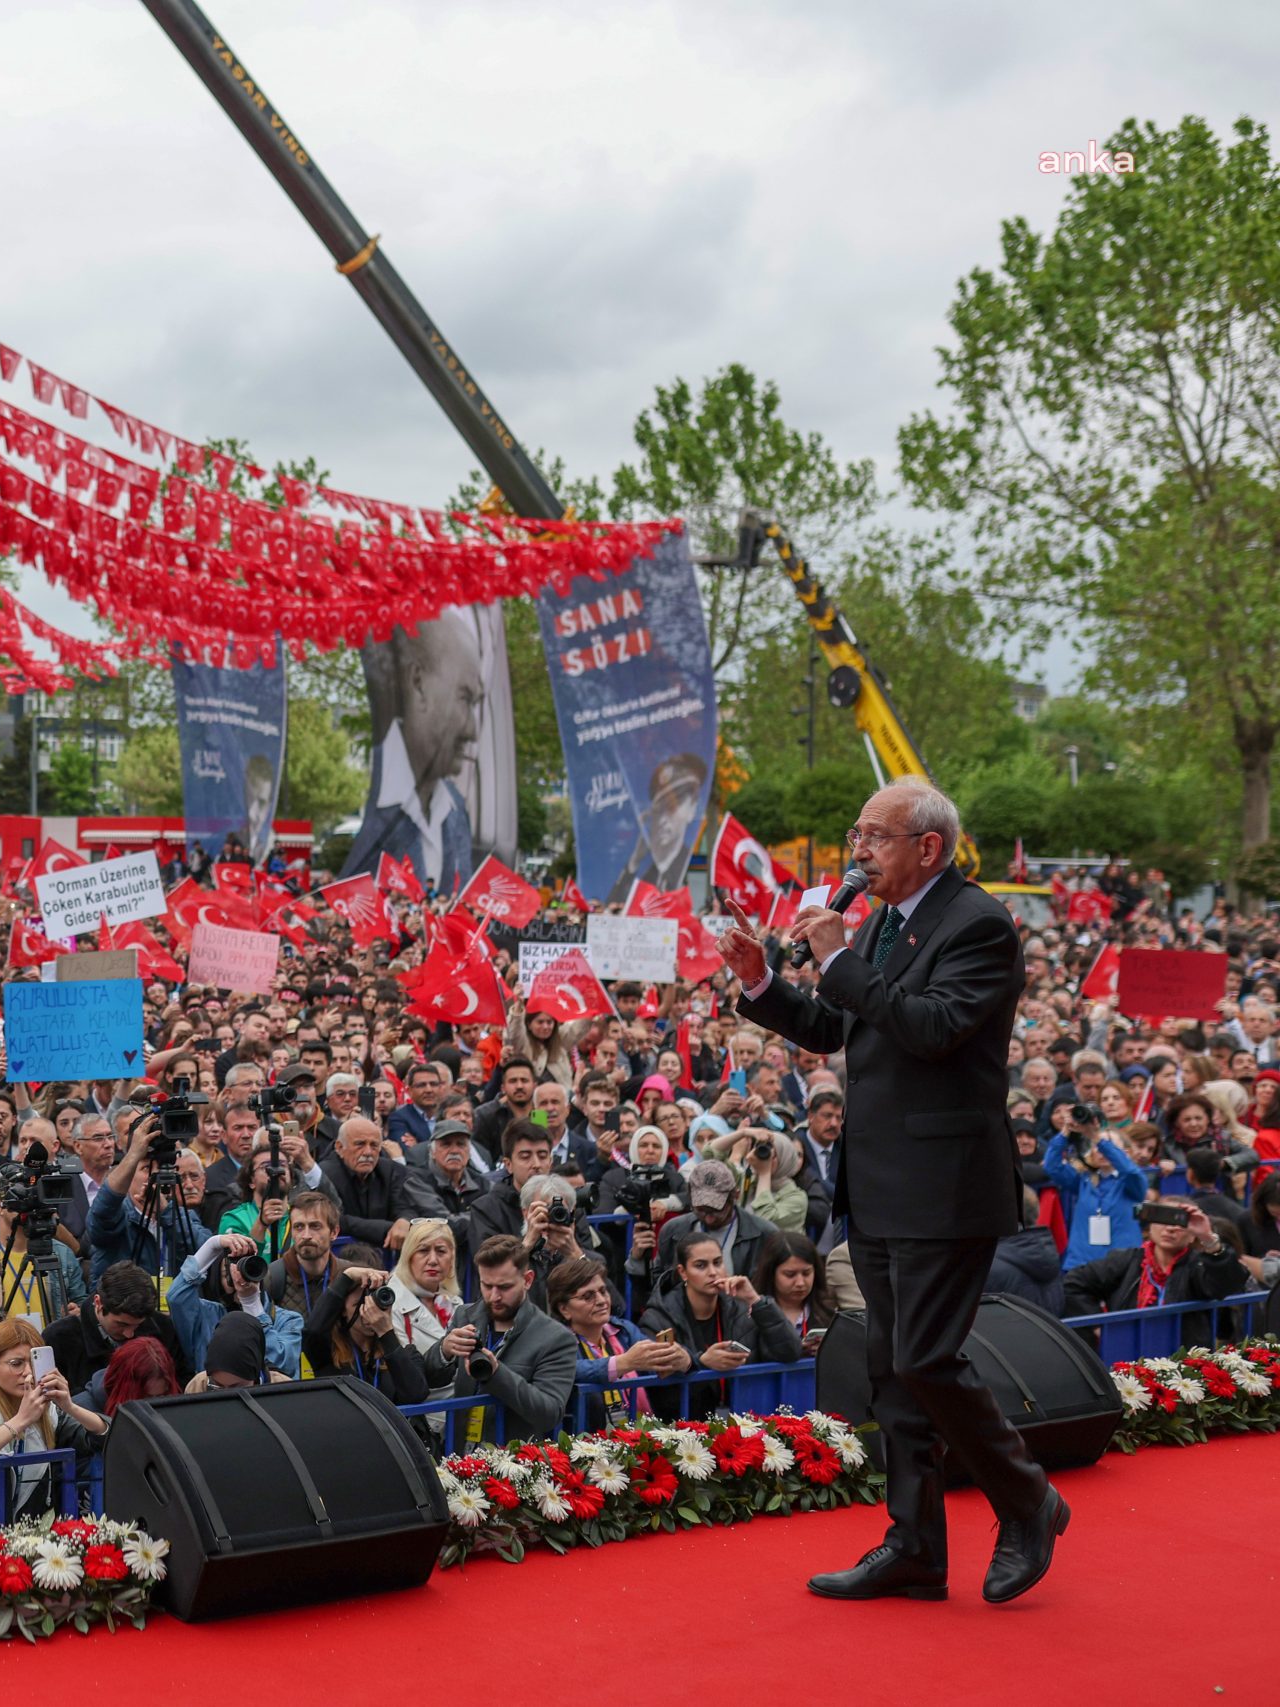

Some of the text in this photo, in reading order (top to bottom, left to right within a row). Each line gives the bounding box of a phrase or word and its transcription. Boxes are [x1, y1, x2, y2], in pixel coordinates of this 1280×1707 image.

[558, 588, 641, 638] SANA
[48, 864, 146, 894] "Orman Üzerine
[42, 877, 161, 918] Çöken Karabulutlar
[117, 896, 145, 914] mi?"
[476, 894, 511, 917] CHP
[8, 1009, 138, 1035] MUSTAFA KEMAL
[26, 1051, 135, 1077] BAY KEMAL
